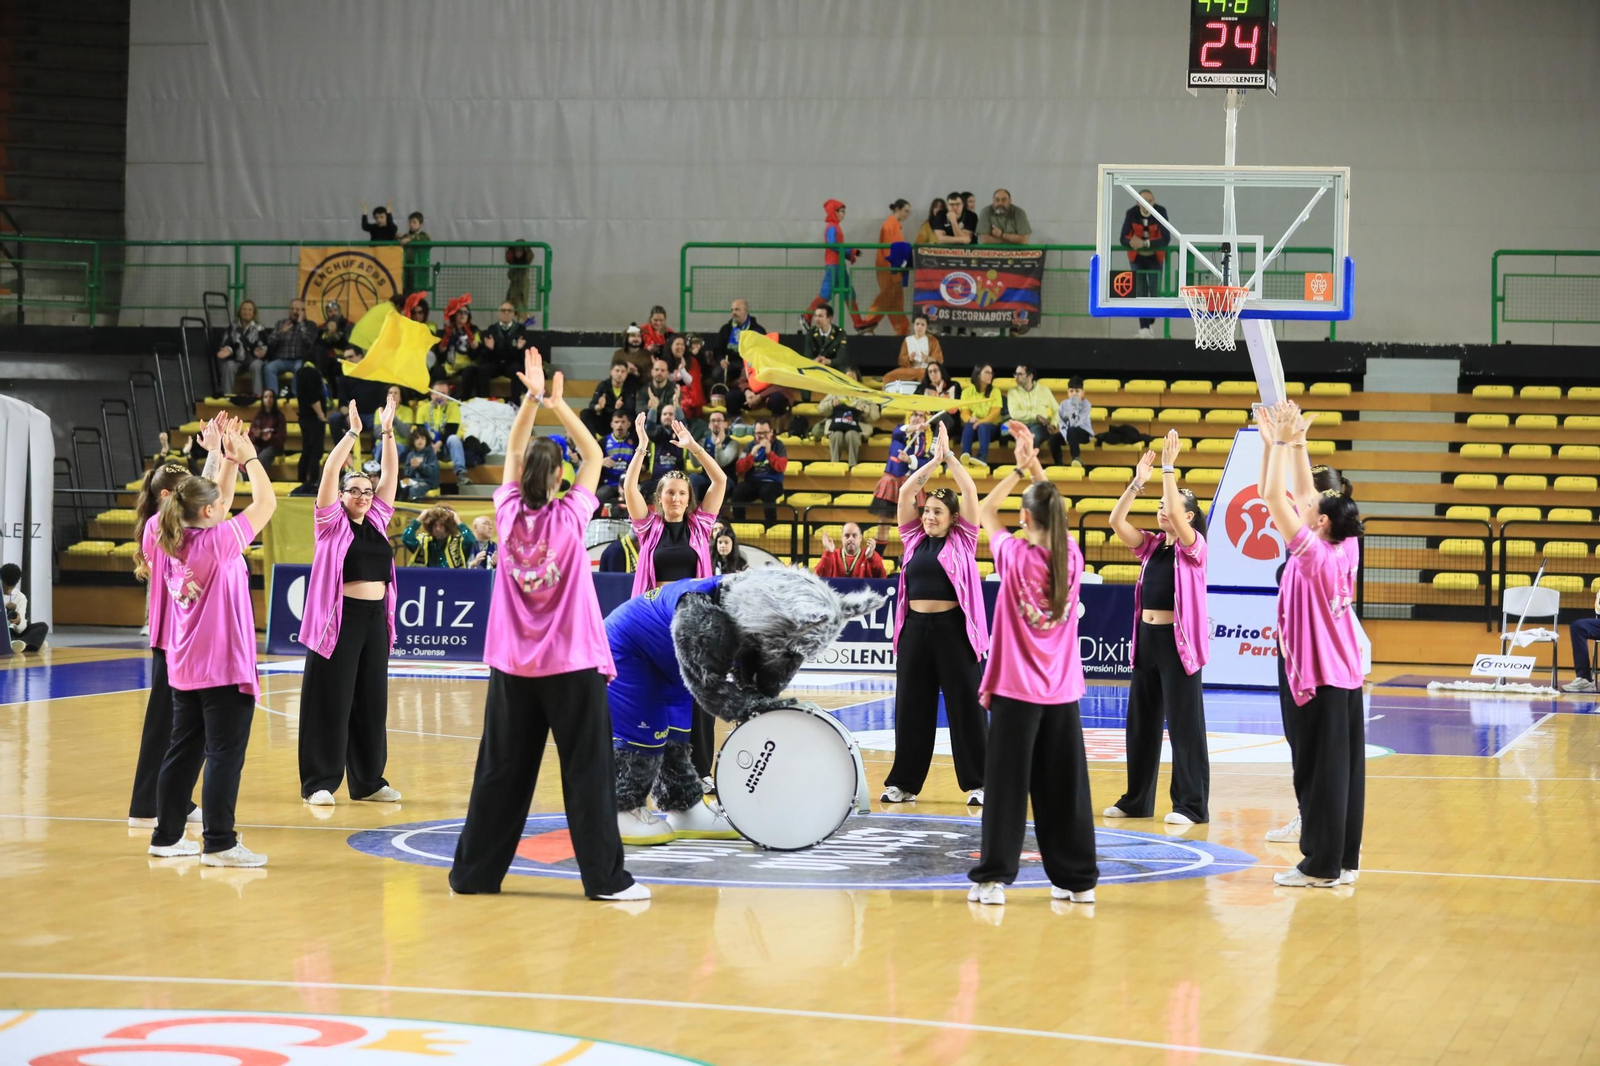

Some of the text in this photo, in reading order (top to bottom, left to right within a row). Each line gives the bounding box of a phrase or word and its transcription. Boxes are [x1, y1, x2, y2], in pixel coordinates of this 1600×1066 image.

[1200, 22, 1259, 68] 24
[1191, 75, 1264, 84] CASADELOSLENTES
[938, 309, 1012, 322] OS ESCORNABOYS
[0, 522, 42, 539] LEZ
[406, 634, 468, 646] SEGUROS
[412, 647, 446, 656] Ourense
